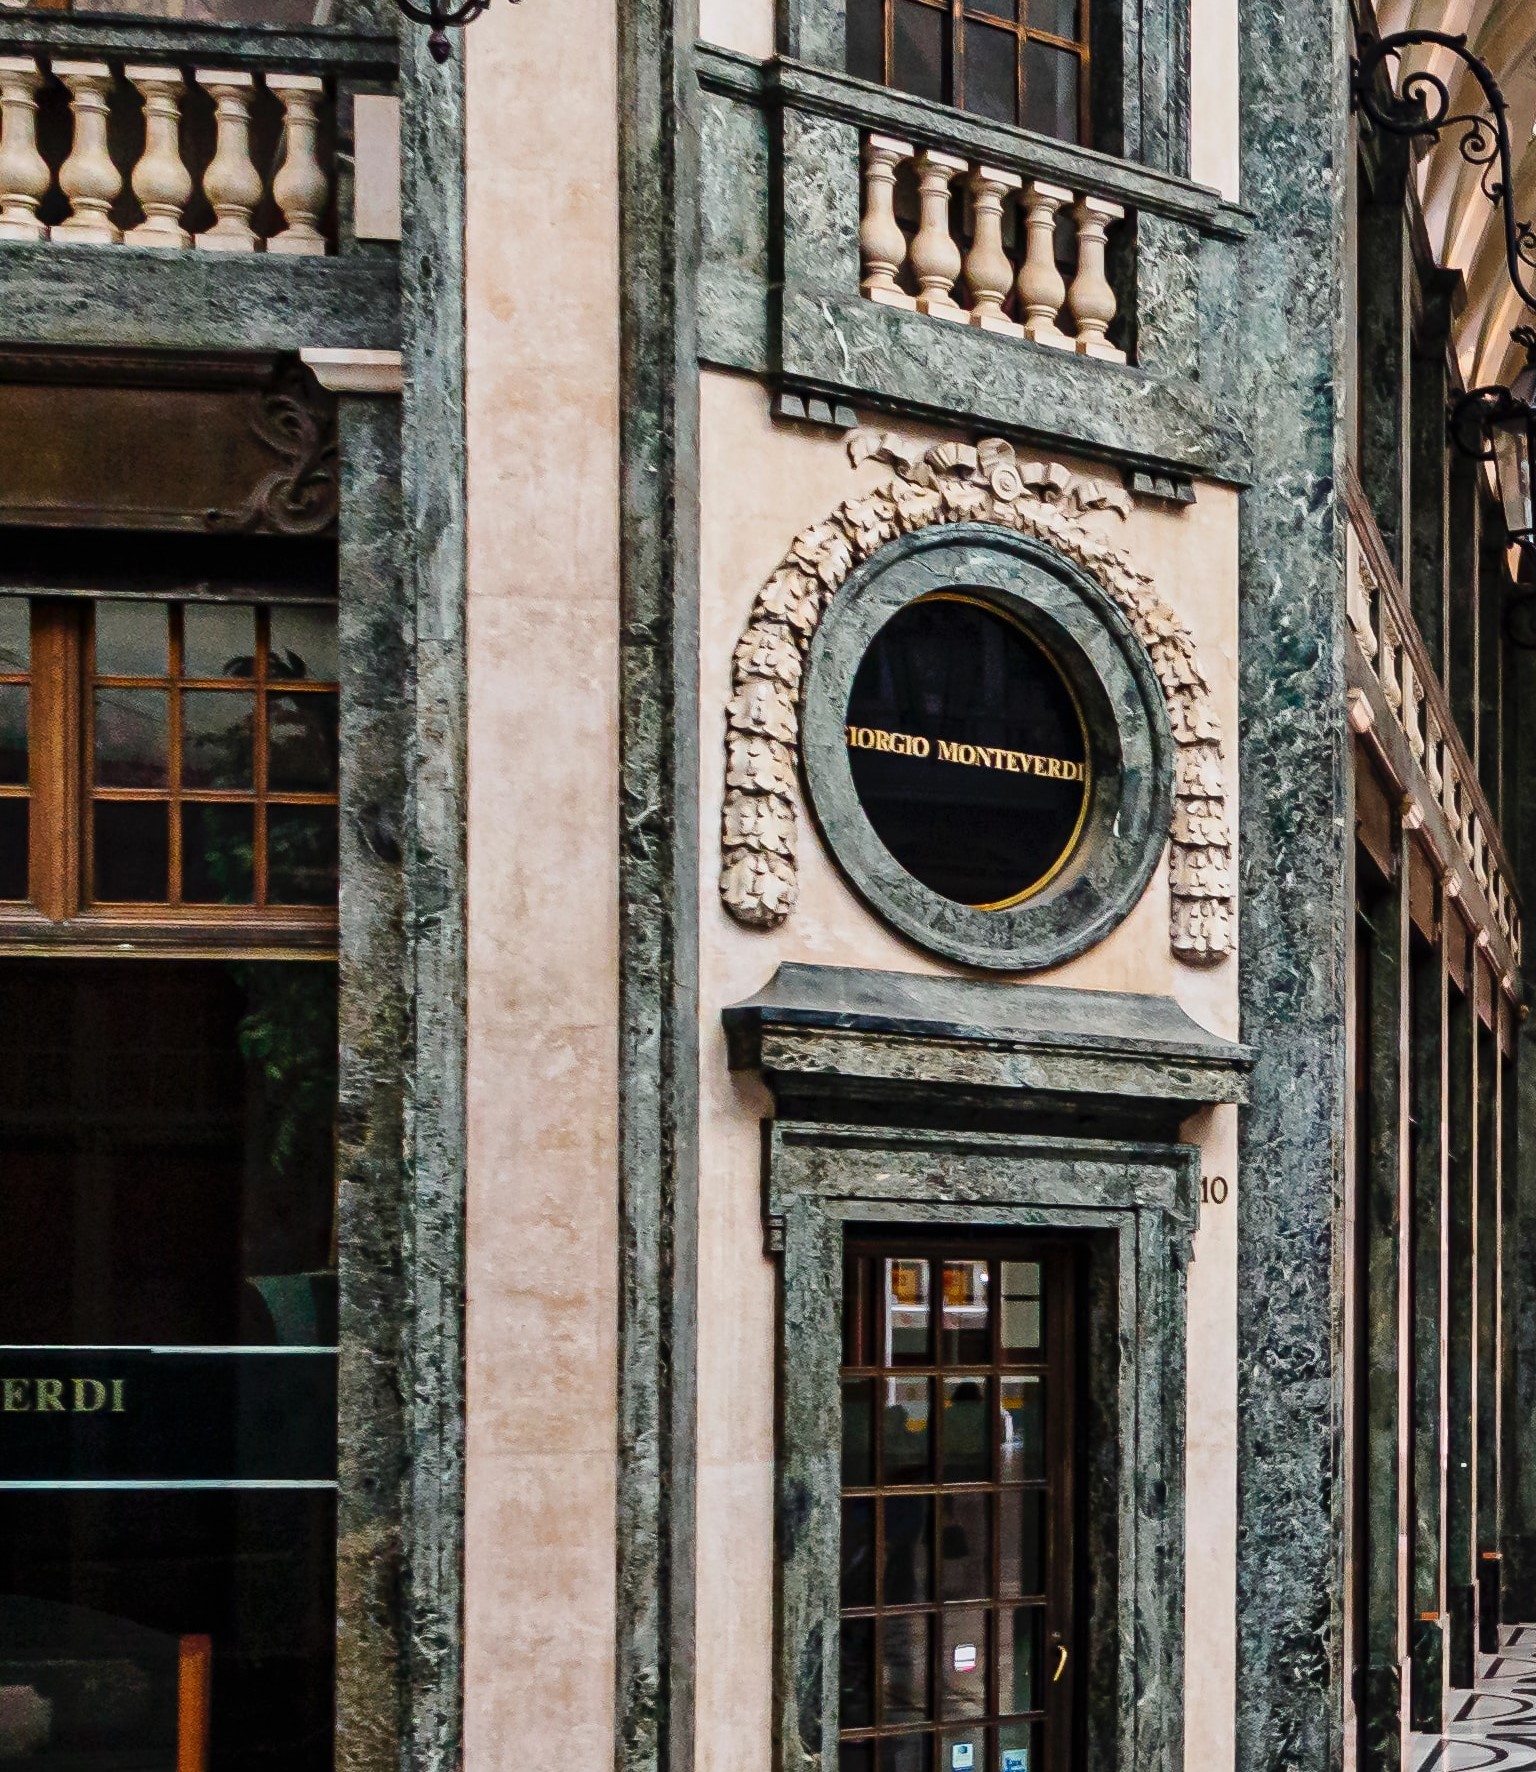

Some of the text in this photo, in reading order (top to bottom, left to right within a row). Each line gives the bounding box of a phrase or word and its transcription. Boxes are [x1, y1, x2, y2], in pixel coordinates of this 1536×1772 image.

[844, 725, 1085, 782] IORGIO MONTEVERDI
[1200, 1176, 1229, 1205] 10
